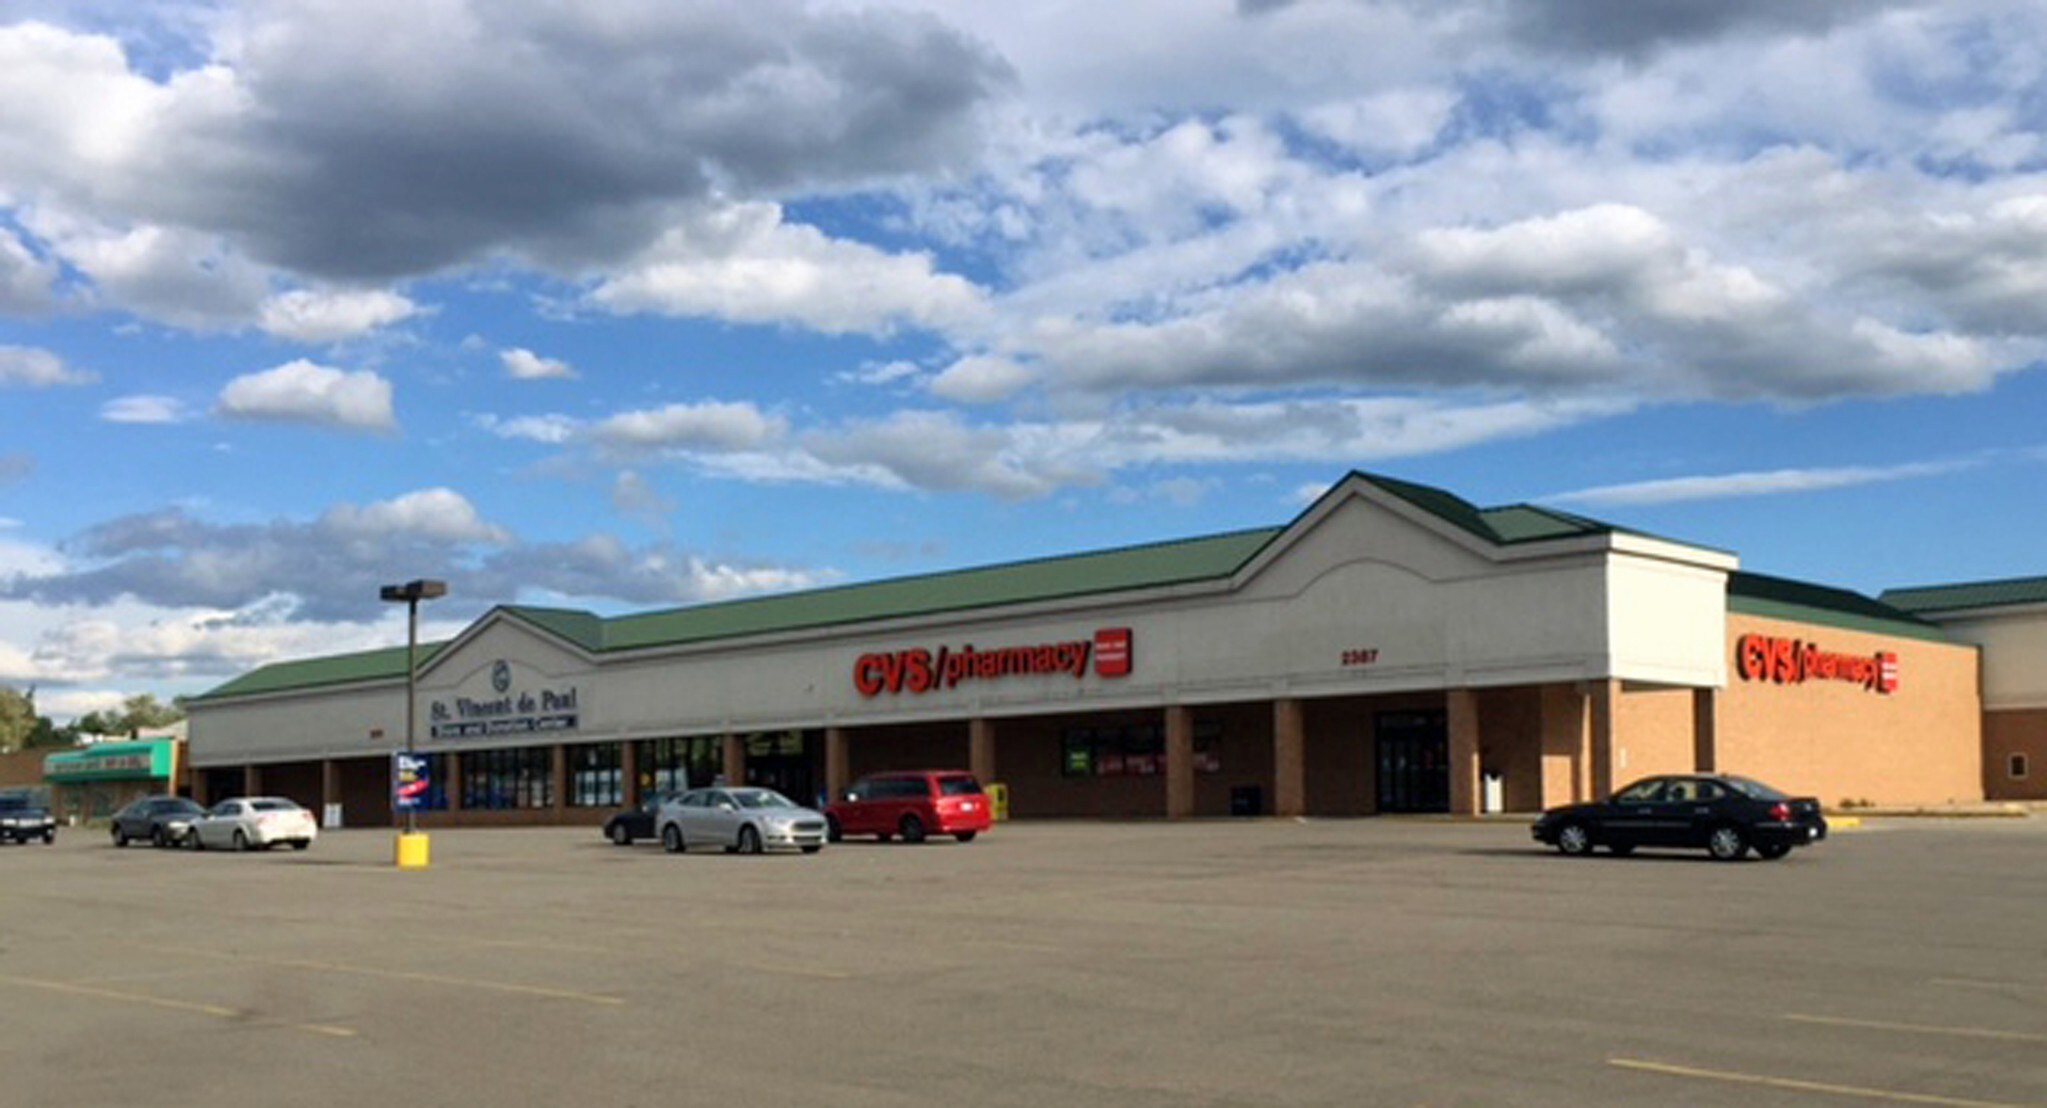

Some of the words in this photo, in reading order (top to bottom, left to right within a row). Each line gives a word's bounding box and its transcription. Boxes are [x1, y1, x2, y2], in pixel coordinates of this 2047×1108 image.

[853, 640, 1091, 696] CVS/pharmacy
[456, 697, 512, 718] Vincent
[518, 691, 536, 714] de
[541, 687, 577, 711] Paul
